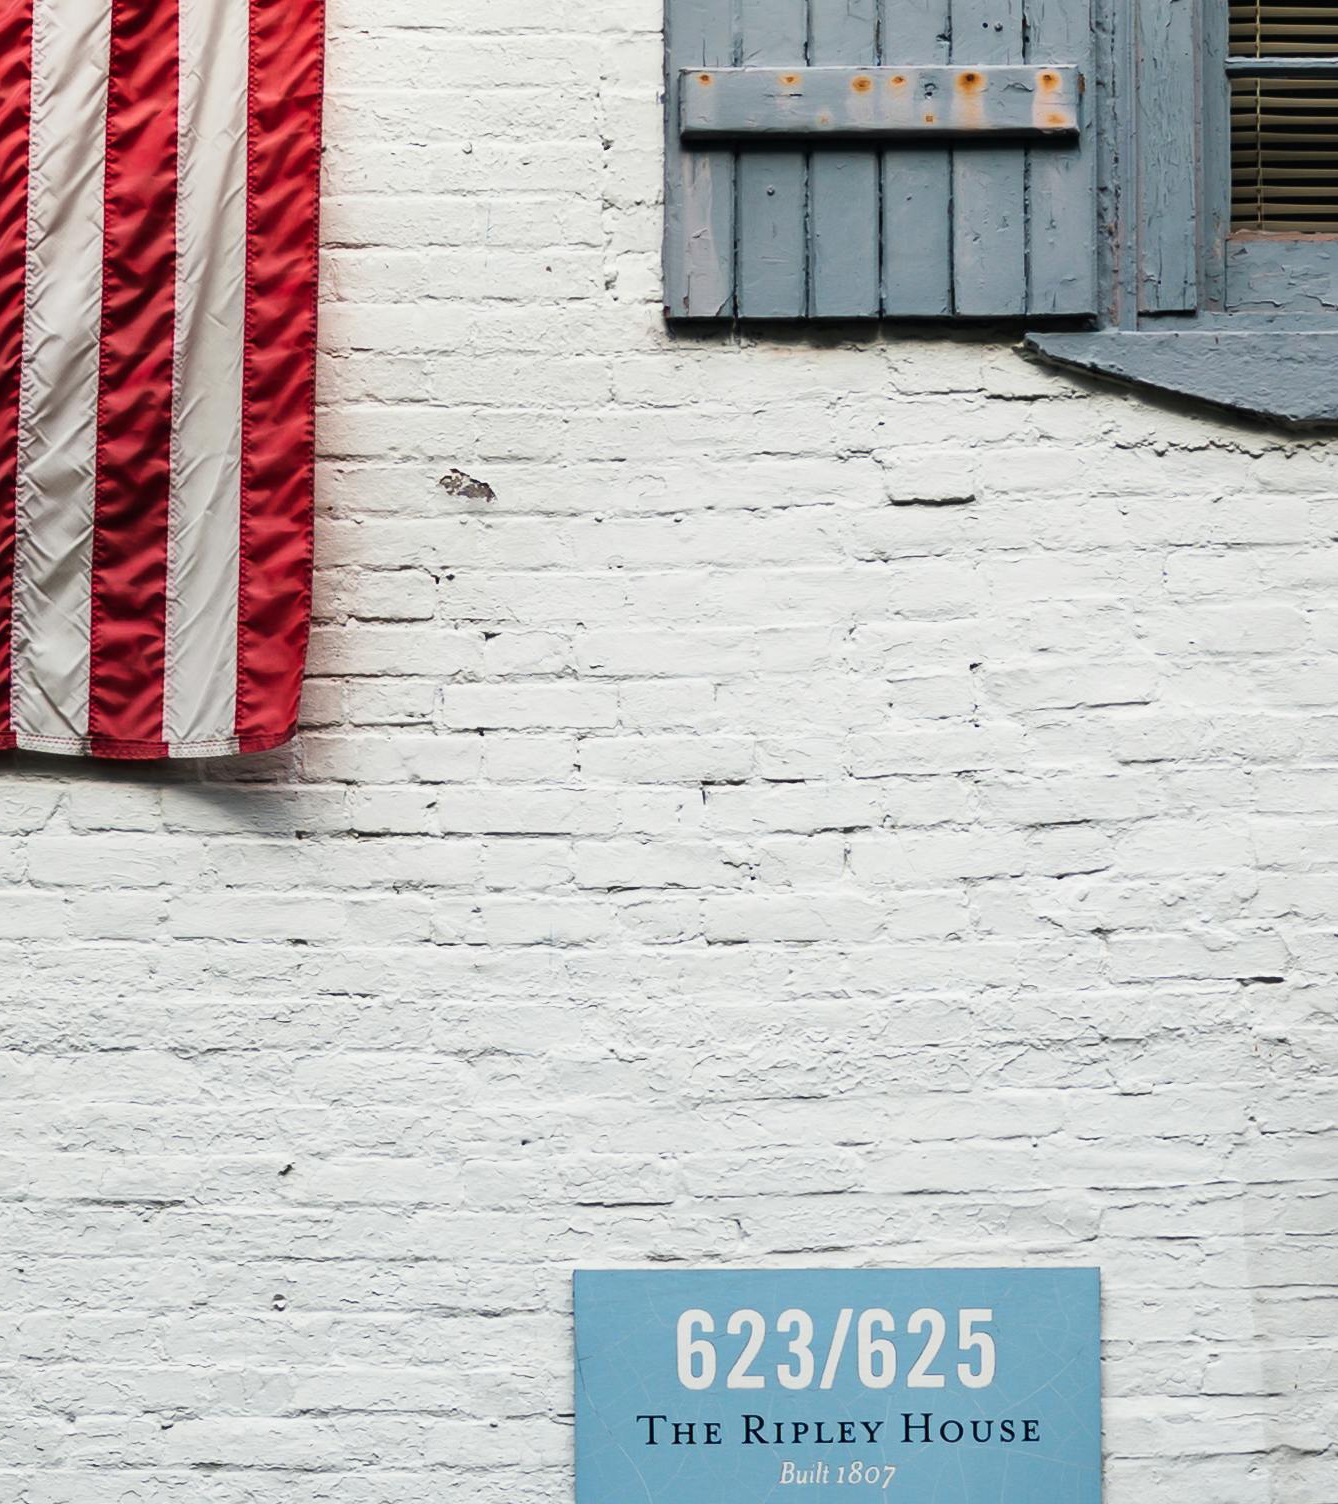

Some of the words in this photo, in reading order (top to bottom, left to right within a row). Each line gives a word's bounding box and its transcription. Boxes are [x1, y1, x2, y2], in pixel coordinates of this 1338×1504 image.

[677, 1308, 996, 1390] 623/625
[636, 1414, 723, 1446] THE
[740, 1413, 885, 1445] RIPLEY
[900, 1411, 1041, 1444] HOUSE
[779, 1461, 830, 1485] Built
[836, 1460, 897, 1489] 1807
